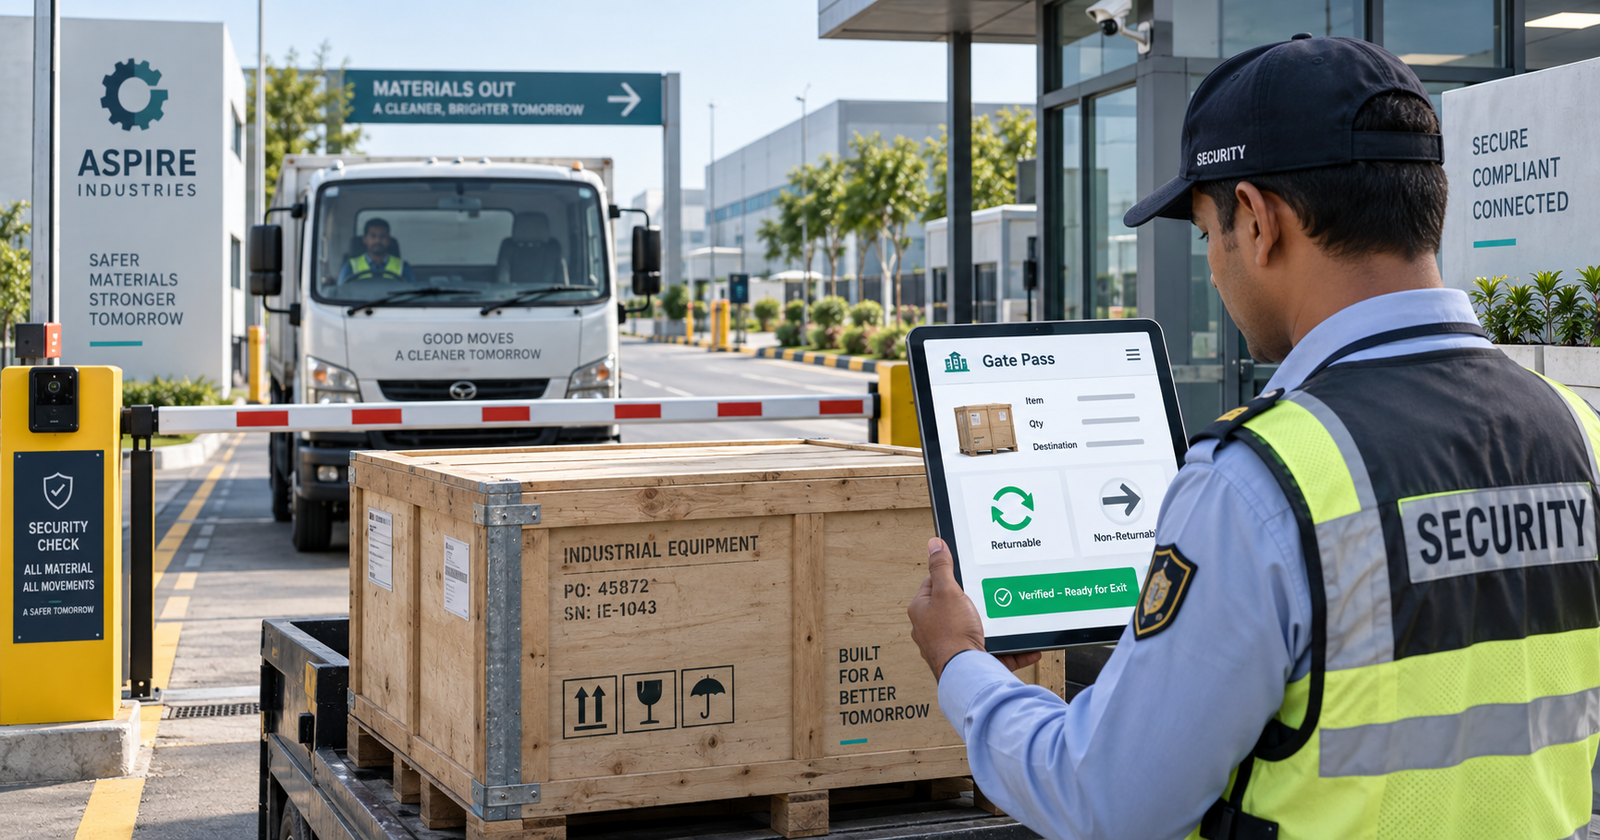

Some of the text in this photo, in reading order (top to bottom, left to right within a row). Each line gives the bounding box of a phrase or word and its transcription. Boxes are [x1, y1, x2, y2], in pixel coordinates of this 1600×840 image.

[373, 80, 516, 98] MATERIALS OUT
[373, 103, 584, 116] A CLEANER, BRIGHTER TOMORROW
[1472, 128, 1528, 155] SECURE
[1196, 144, 1246, 166] SECURITY
[78, 149, 196, 176] ASPIRE
[1472, 156, 1560, 188] COMPLIANT
[78, 184, 196, 197] INDUSTRIES
[1472, 191, 1568, 220] CONNECTED
[90, 254, 140, 267] SAFER
[90, 273, 178, 286] MATERIALS
[90, 292, 176, 306] STRONGER
[89, 312, 184, 326] TOMORROW
[423, 332, 514, 344] GOOD MOVES
[395, 349, 541, 361] A CLEANER TOMORROW
[982, 352, 1056, 368] Gate Pass
[1026, 396, 1044, 405] Item
[1029, 419, 1044, 429] Qty
[1033, 440, 1078, 451] Destination
[28, 520, 88, 534] SECURITY
[1417, 499, 1586, 564] SECURITY
[1094, 529, 1156, 542] Non-Returnab
[37, 538, 80, 551] CHECK
[564, 536, 758, 564] INDUSTRIAL EQUIPMENT
[991, 538, 1041, 550] Returnable
[24, 562, 93, 576] ALL MATERIAL
[23, 580, 94, 592] ALL MOVEMENTS
[564, 579, 649, 599] PO: 45872
[1018, 588, 1054, 600] Verified
[1064, 585, 1092, 598] Ready
[1094, 584, 1108, 594] for
[1110, 582, 1128, 593] Exit
[23, 606, 94, 616] A SAFER TOMORROW
[564, 600, 657, 621] SN: IE-1043
[839, 646, 880, 663] BUILT
[840, 666, 884, 684] FOR A
[840, 686, 896, 705] BETTER
[840, 703, 930, 726] TOMORROW
